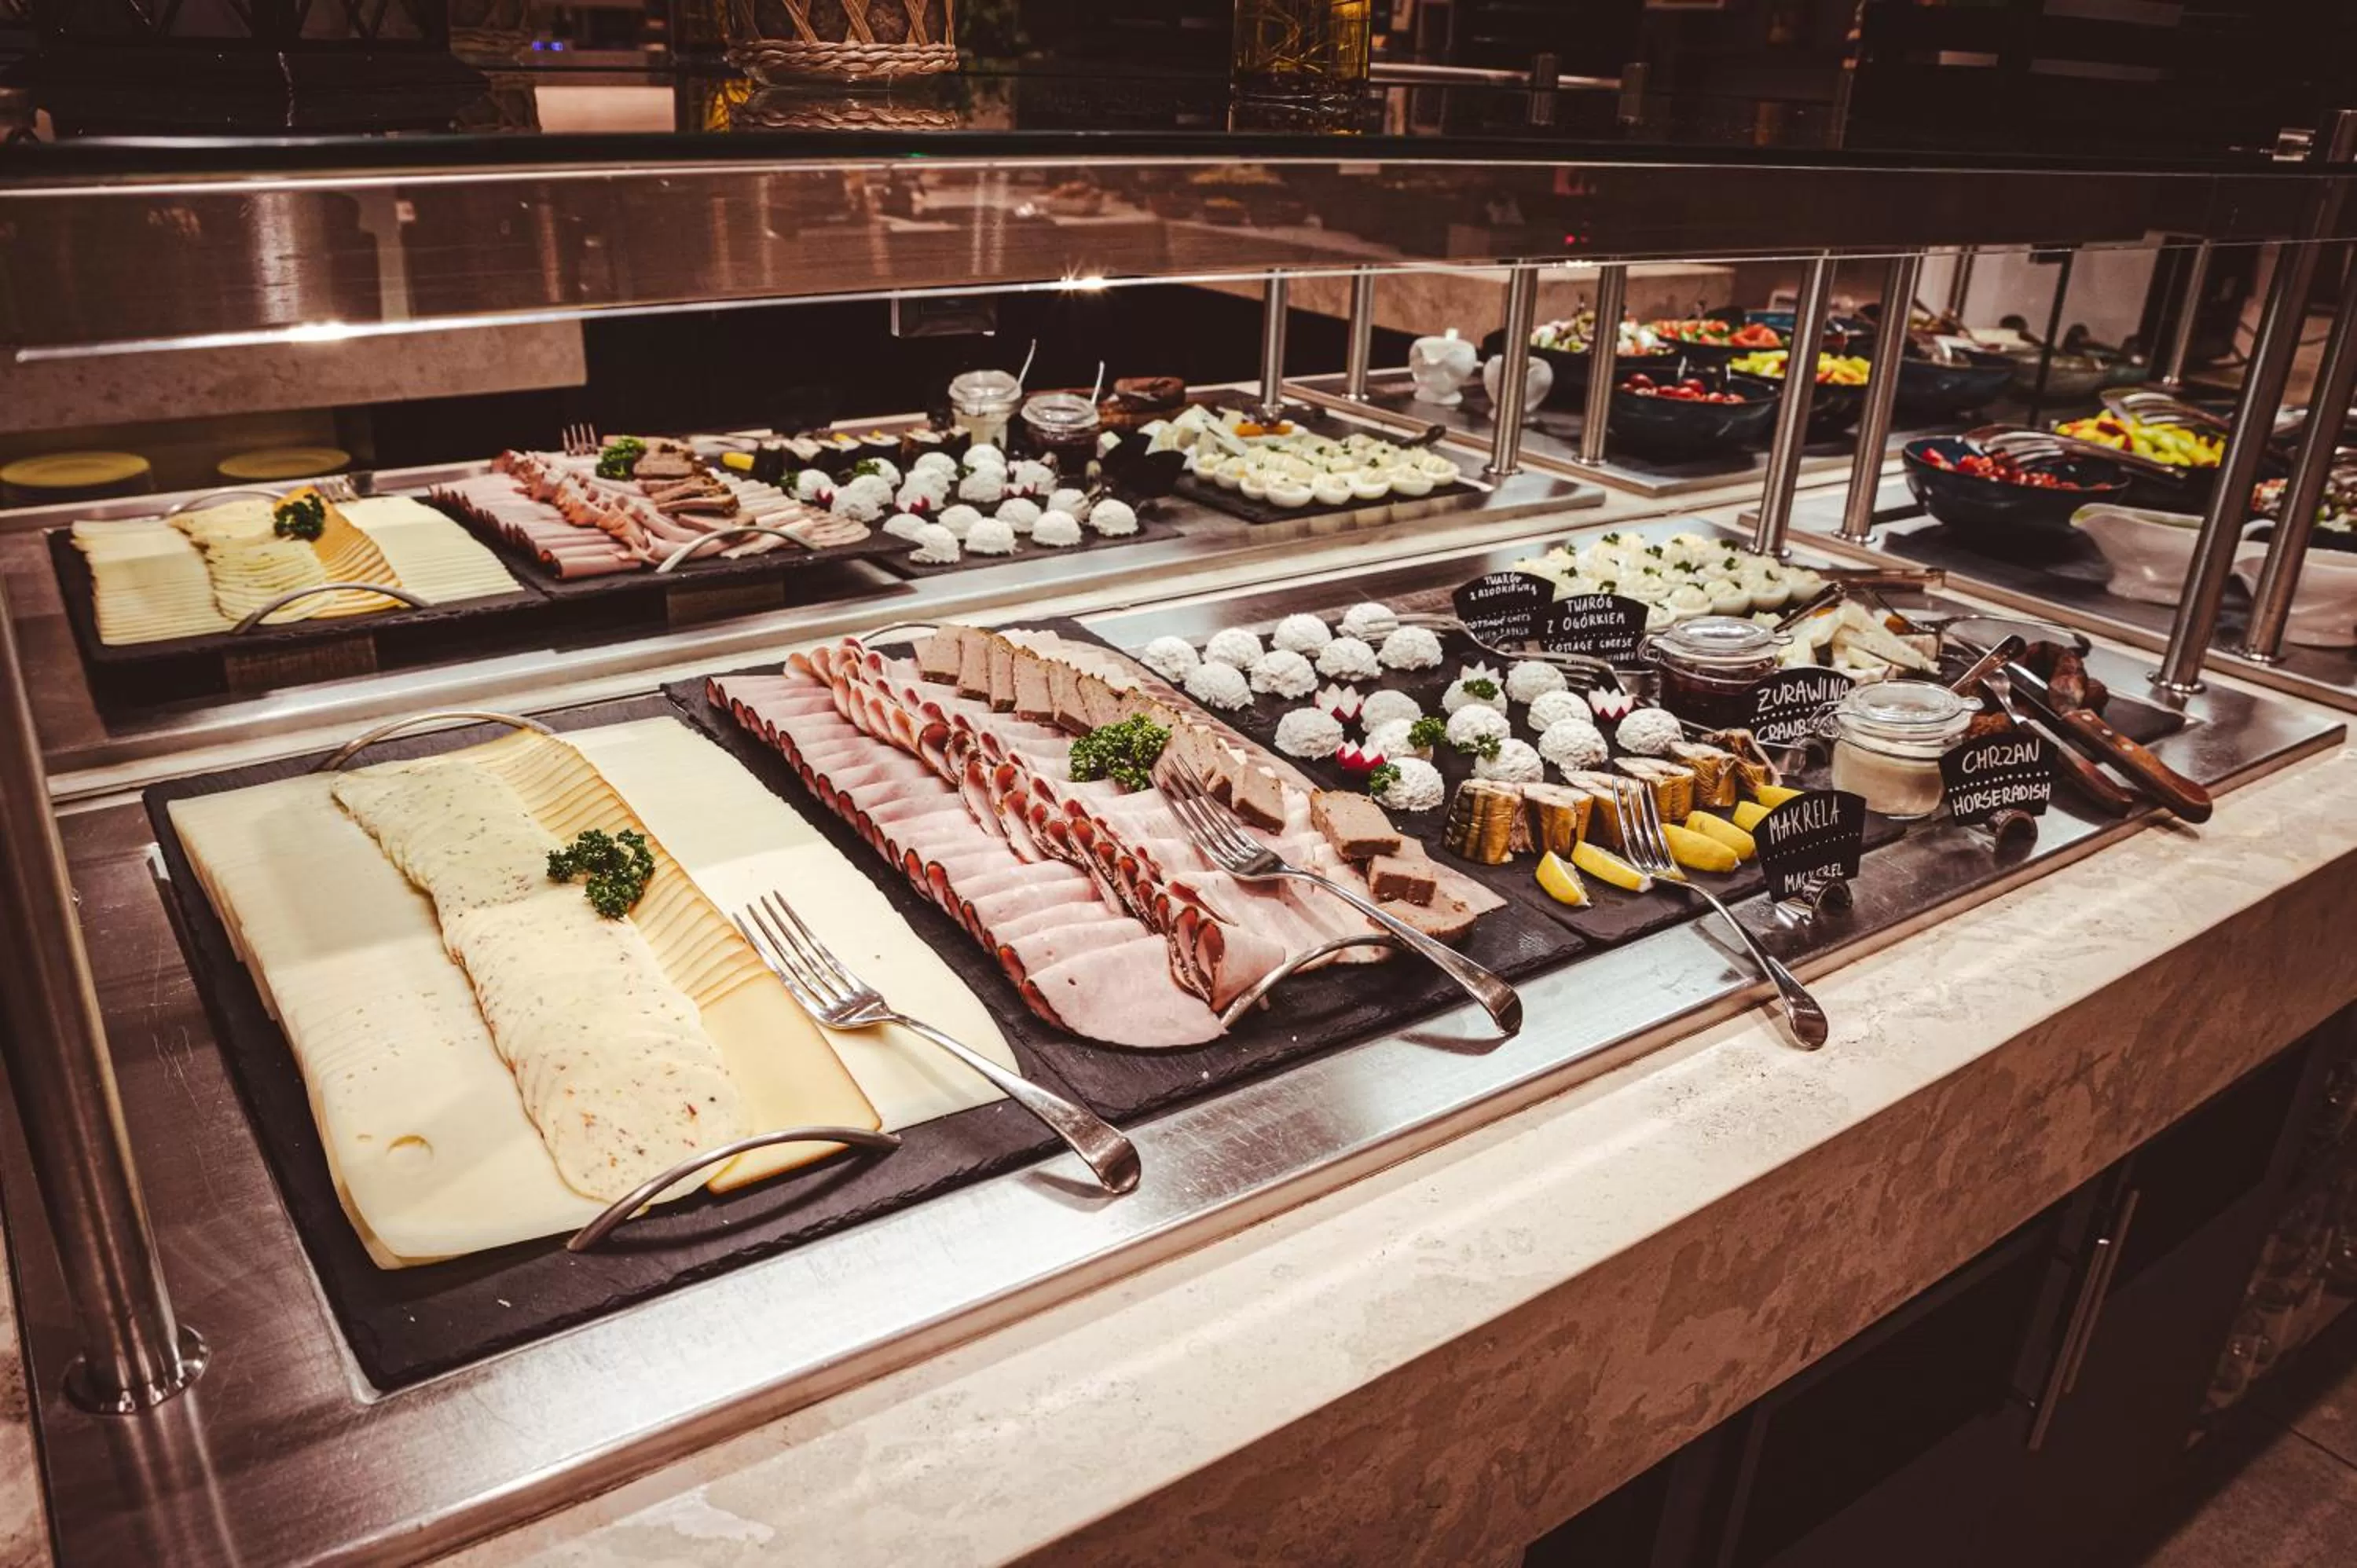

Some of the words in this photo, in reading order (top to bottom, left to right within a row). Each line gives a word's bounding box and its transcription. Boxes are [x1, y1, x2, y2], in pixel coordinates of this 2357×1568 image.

[1566, 595, 1614, 613] TWARÓG
[1547, 621, 1554, 634] Z
[1563, 612, 1626, 631] OGÓRKIEM
[1549, 640, 1593, 653] COTTAGE
[1599, 637, 1633, 649] CHEESE
[1962, 738, 2040, 774] CHRZAN
[1952, 782, 2051, 816] HORSERADISH
[1769, 794, 1840, 845] MAKRELA
[1784, 862, 1845, 893] MACKEREL
